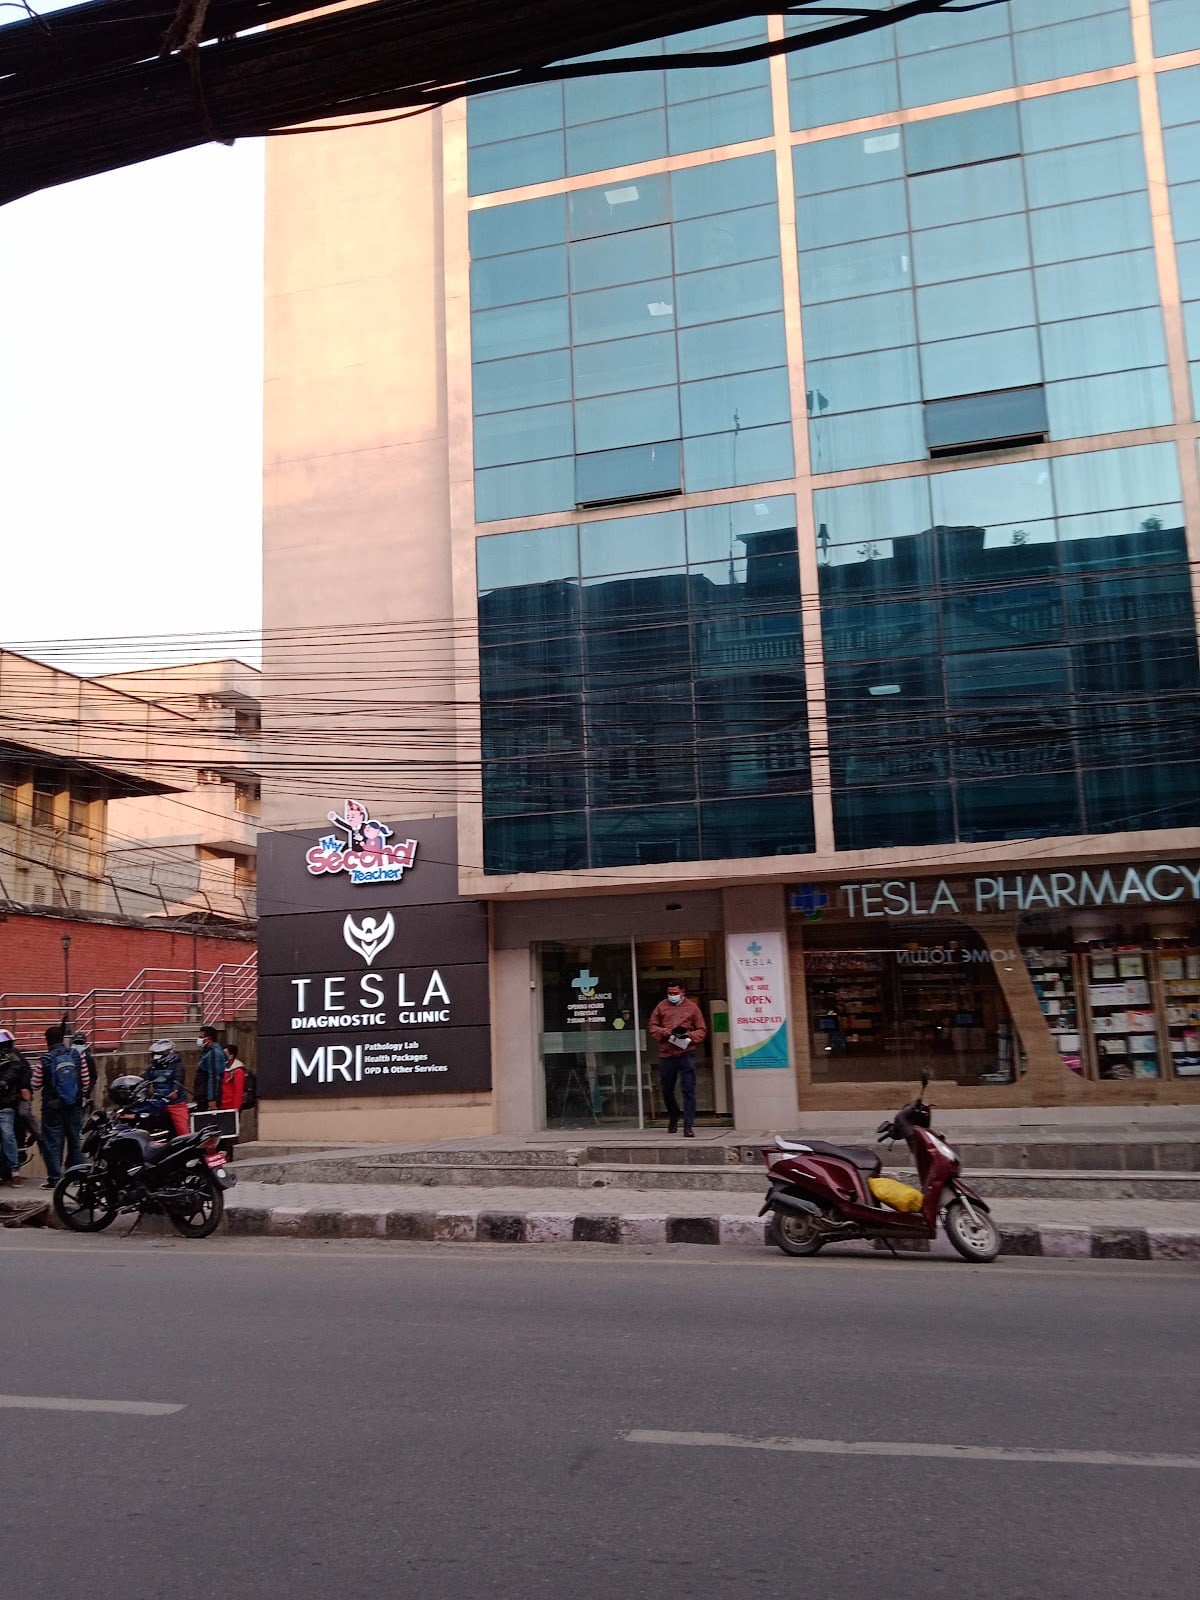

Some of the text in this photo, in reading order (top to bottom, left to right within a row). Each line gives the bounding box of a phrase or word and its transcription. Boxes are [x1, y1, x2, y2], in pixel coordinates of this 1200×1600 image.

[321, 837, 342, 854] My
[307, 841, 415, 873] Second
[351, 867, 401, 882] Teacher
[840, 864, 1200, 919] TESLA PHARMACY
[291, 969, 451, 1013] TESLA
[745, 996, 771, 1005] OPEN
[291, 1009, 450, 1030] DIAGNOSTIC CLINIC
[364, 1041, 419, 1051] Pathology Lab
[291, 1045, 362, 1084] MRI
[364, 1053, 428, 1062] Health Packages
[364, 1066, 381, 1074] OPD
[390, 1065, 413, 1073] Other
[414, 1064, 448, 1073] Services
